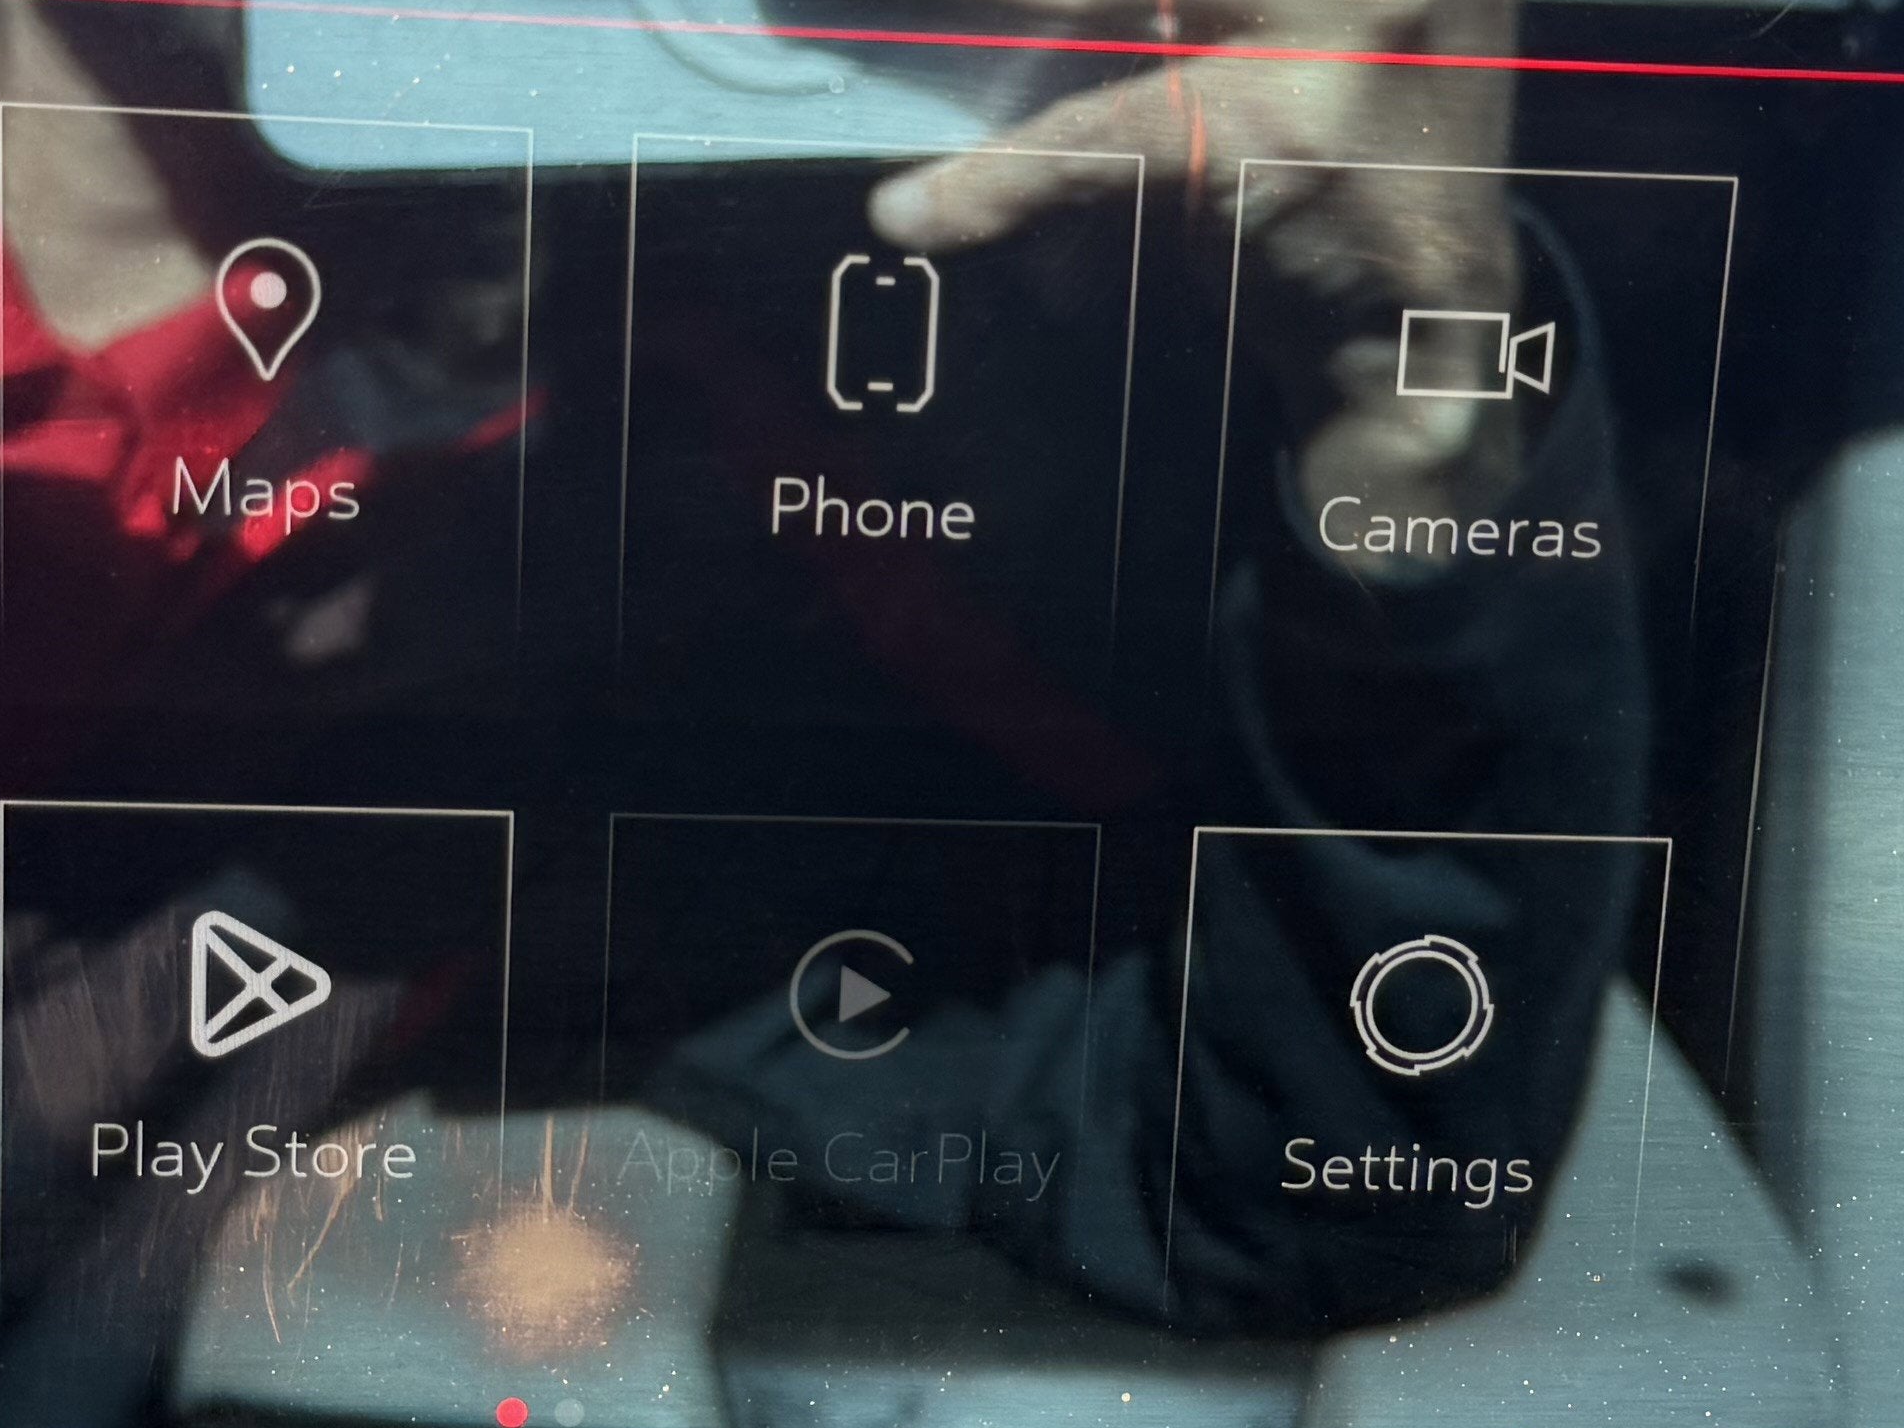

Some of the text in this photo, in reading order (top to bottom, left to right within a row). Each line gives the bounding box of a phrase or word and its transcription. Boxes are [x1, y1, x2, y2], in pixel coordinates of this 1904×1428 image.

[171, 456, 361, 536] Maps
[770, 474, 977, 542] Phone
[1317, 495, 1603, 559] Cameras
[90, 1121, 417, 1195] Play Store
[616, 1127, 1061, 1202] Apple CarPlay
[1279, 1137, 1535, 1210] Settings
